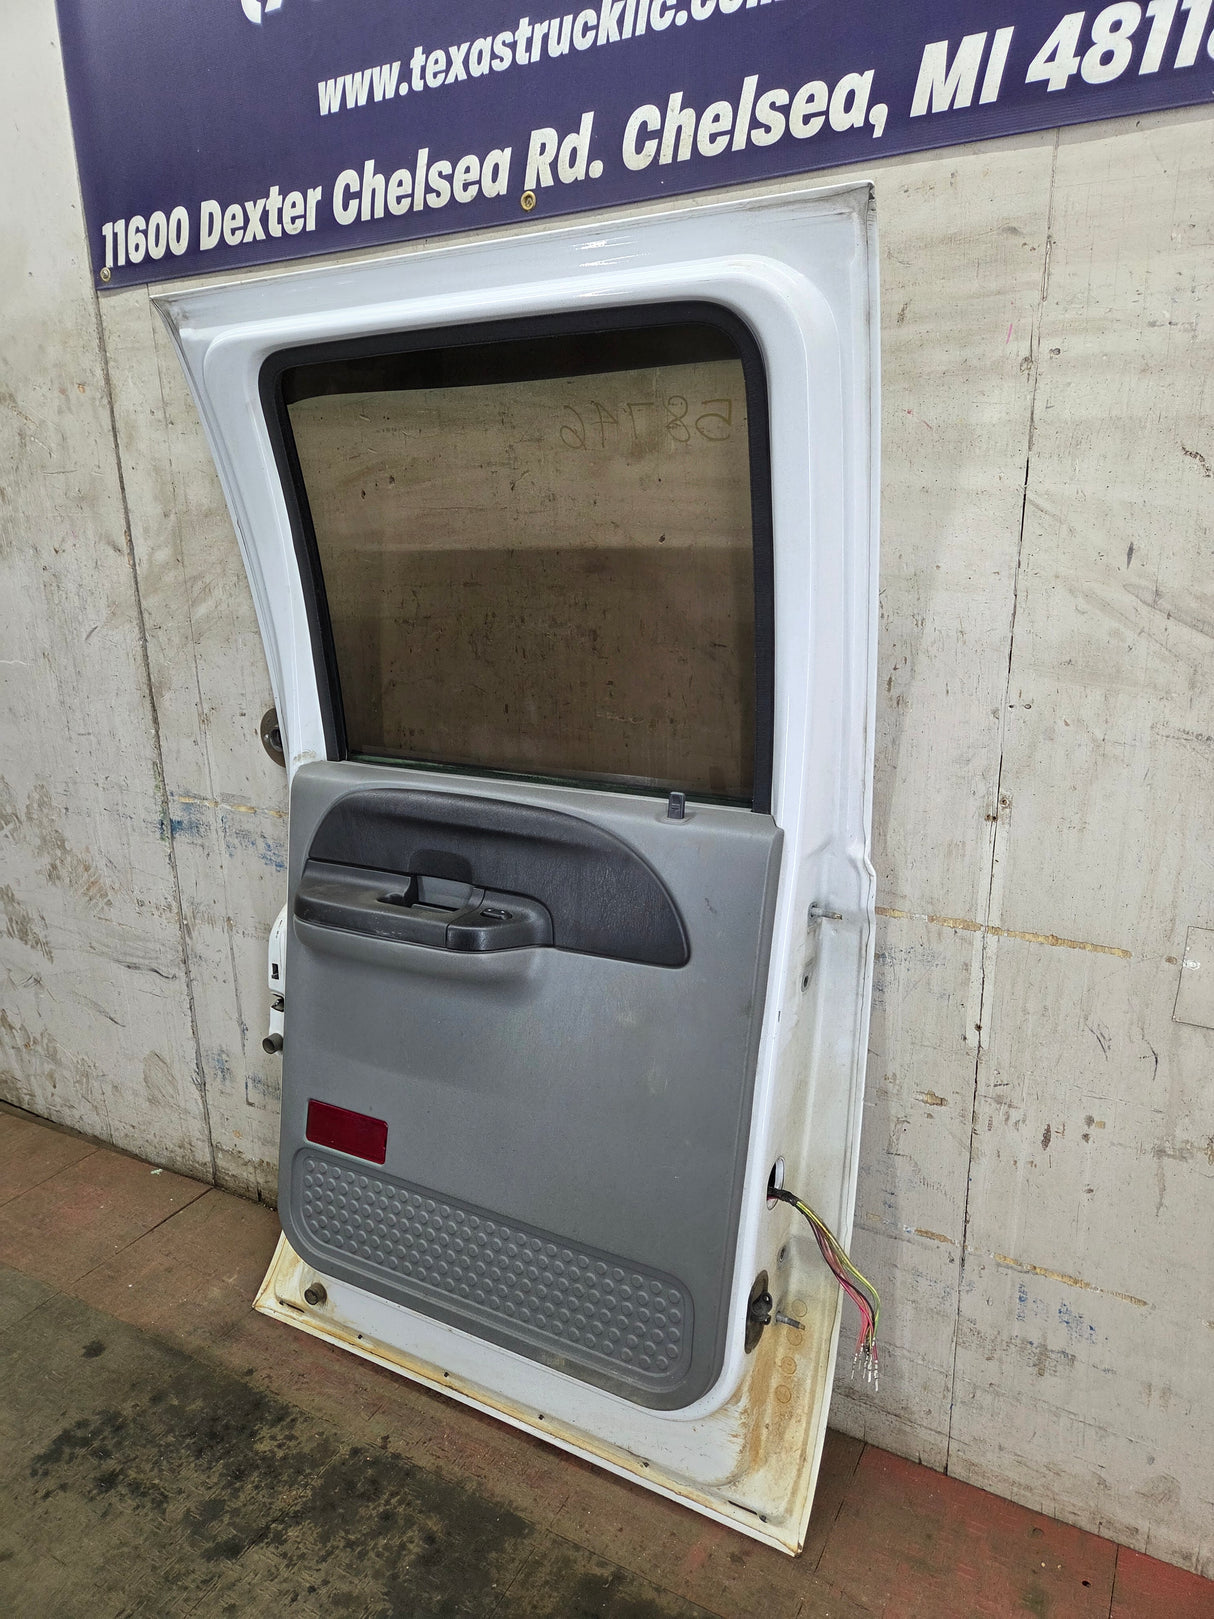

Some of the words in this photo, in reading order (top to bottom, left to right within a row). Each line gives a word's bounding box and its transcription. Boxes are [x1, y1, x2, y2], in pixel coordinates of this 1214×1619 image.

[101, 205, 190, 269] 11600
[199, 185, 323, 251] Dexter
[332, 147, 513, 226] Chelsea
[523, 110, 604, 191] Rd.
[622, 69, 889, 171] Chelsea,
[909, 26, 1015, 118] MI
[1024, 0, 1214, 92] 4811
[317, 0, 785, 116] www.texastruckllc.
